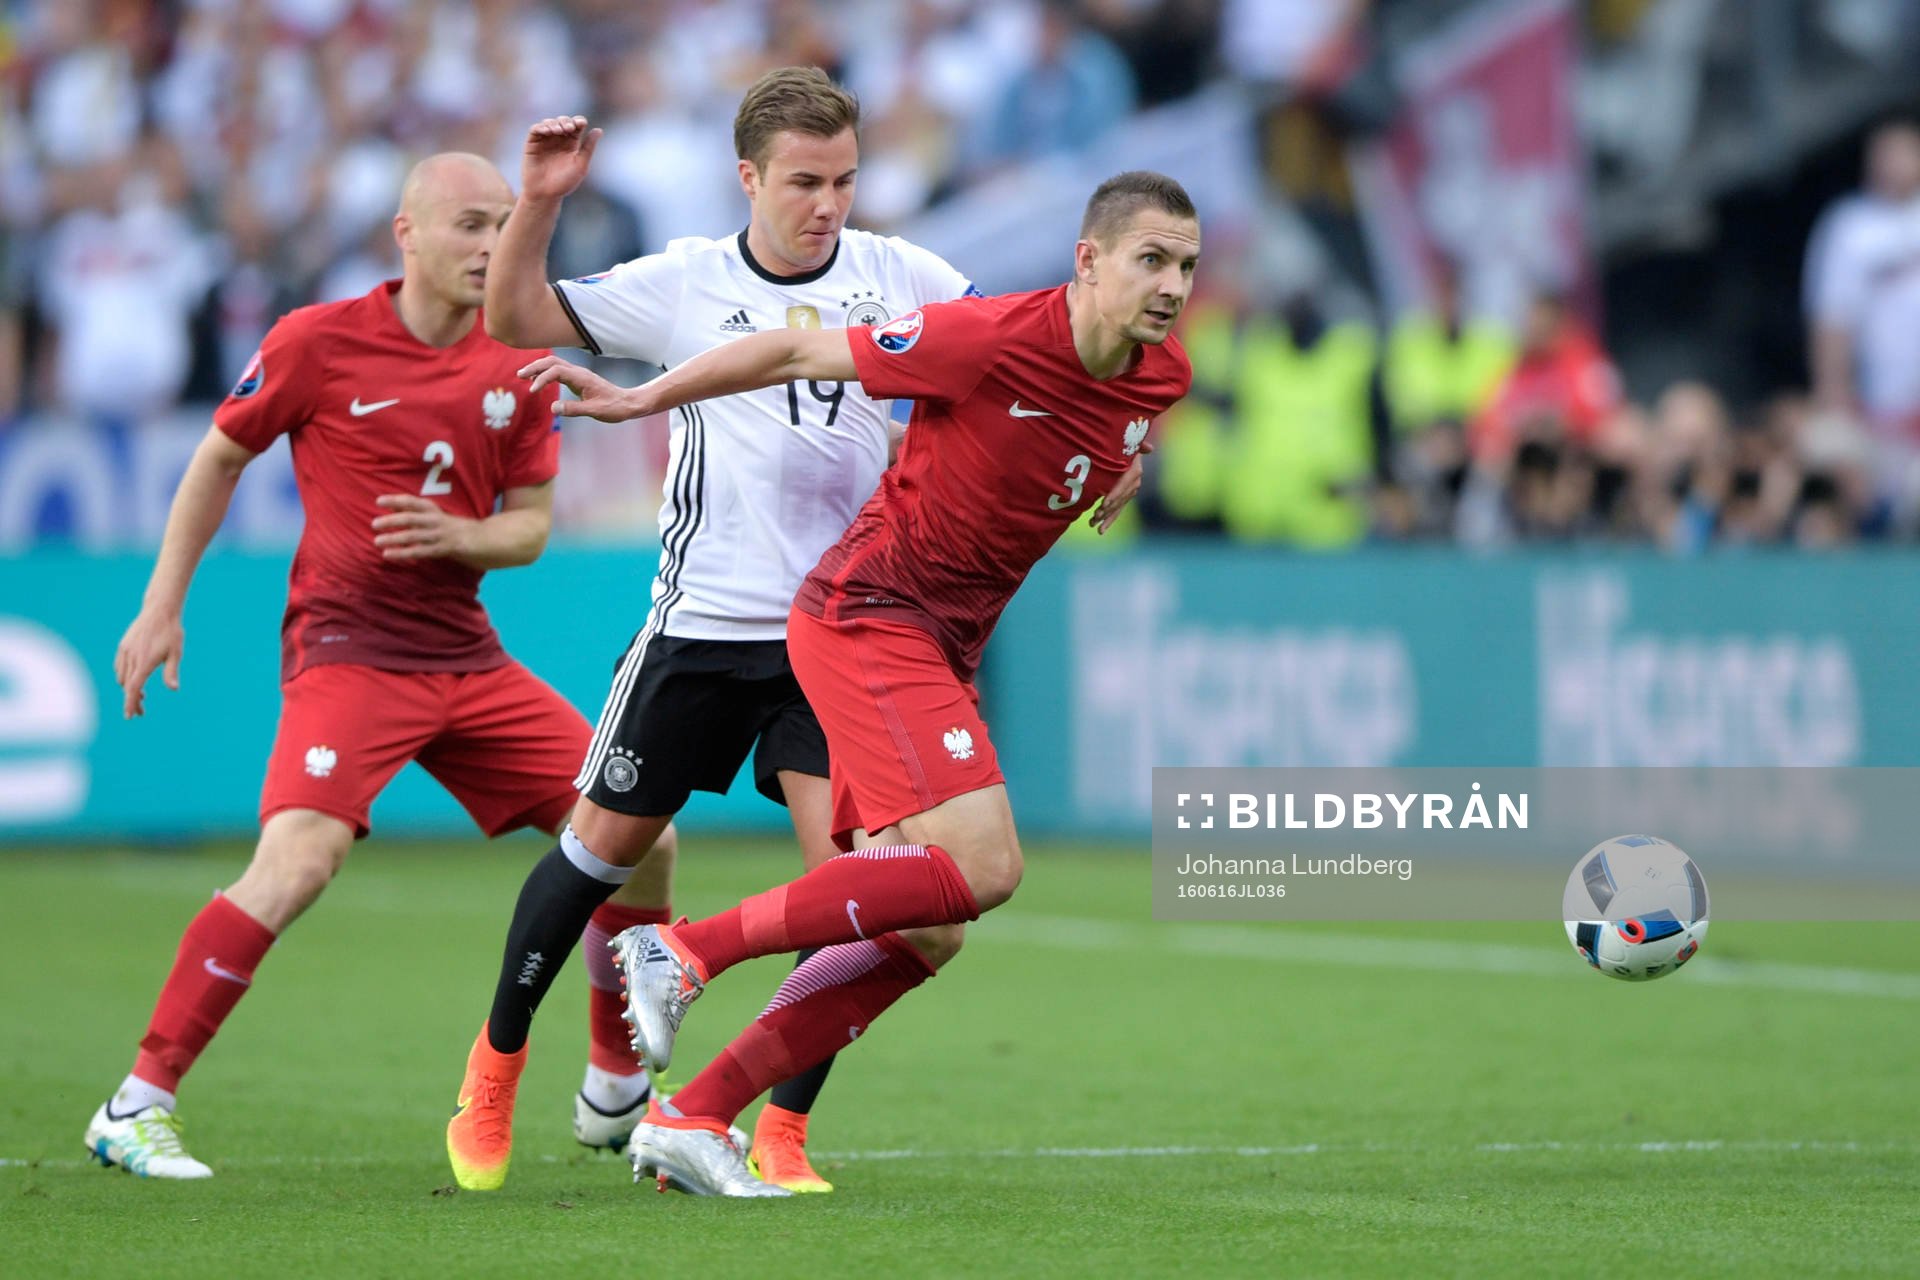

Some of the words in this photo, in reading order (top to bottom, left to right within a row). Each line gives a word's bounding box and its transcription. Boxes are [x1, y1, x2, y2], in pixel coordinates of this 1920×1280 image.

[720, 324, 757, 333] adidas
[787, 380, 845, 426] 19
[420, 440, 454, 496] 2
[1048, 455, 1091, 510] 3
